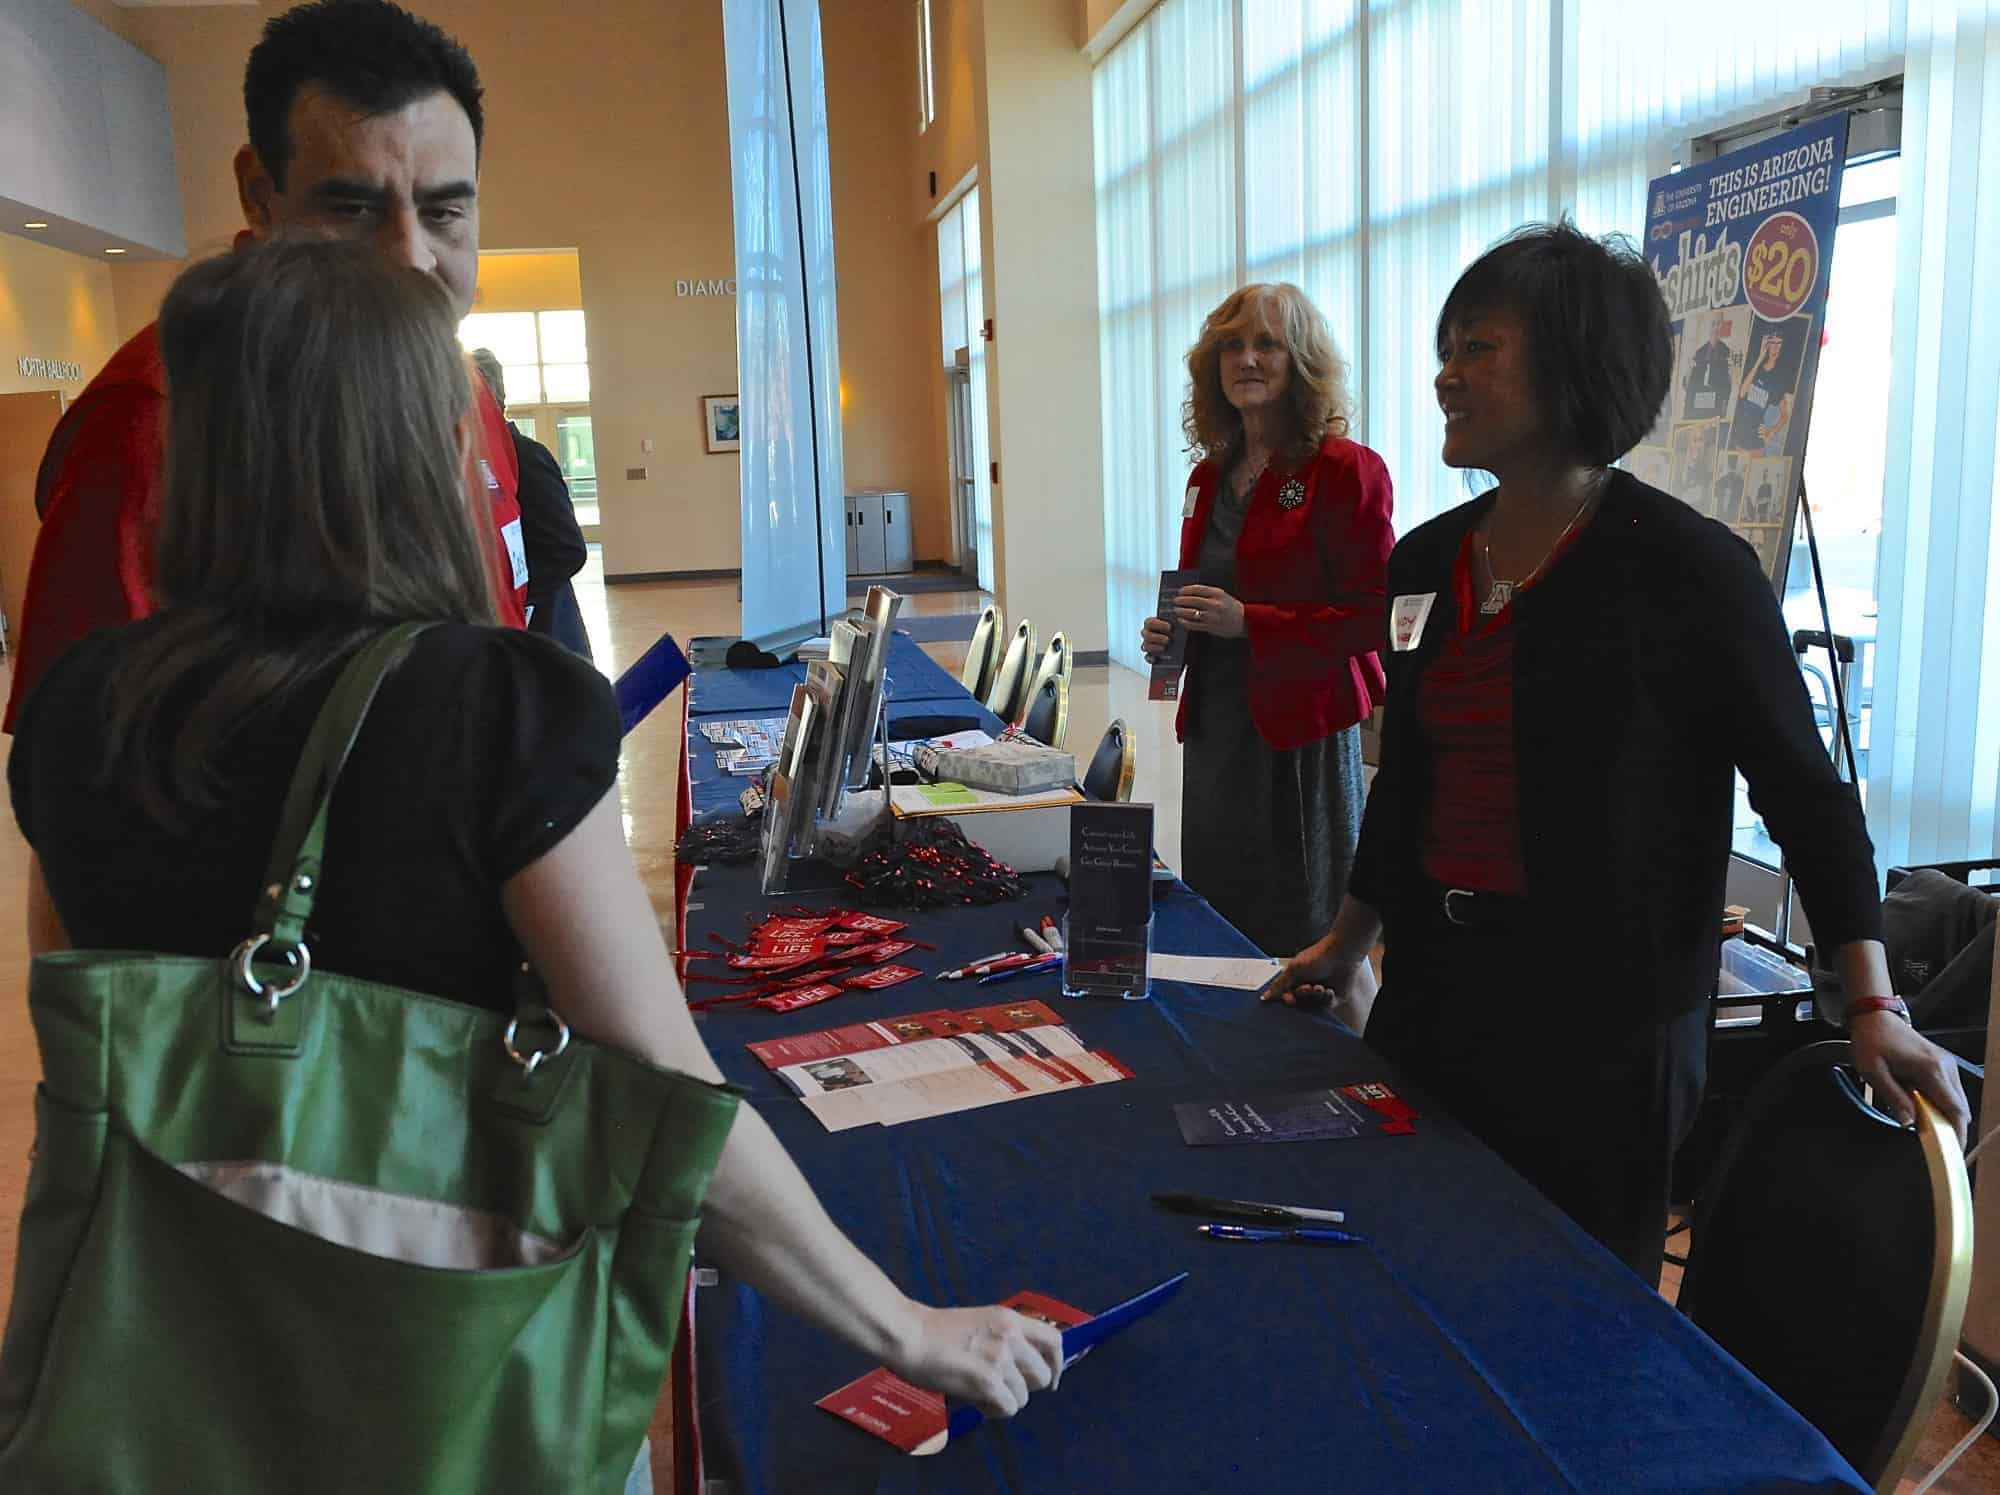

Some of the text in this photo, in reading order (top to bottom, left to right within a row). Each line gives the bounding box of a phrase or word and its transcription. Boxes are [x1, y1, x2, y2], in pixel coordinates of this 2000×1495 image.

[1709, 136, 1834, 199] THIS IS ARIZONA
[1705, 165, 1832, 227] ENGINEERING!
[1748, 240, 1812, 304] $20
[17, 354, 46, 377] NORTH
[772, 944, 813, 954] LIFE
[788, 987, 827, 1004] LIFE
